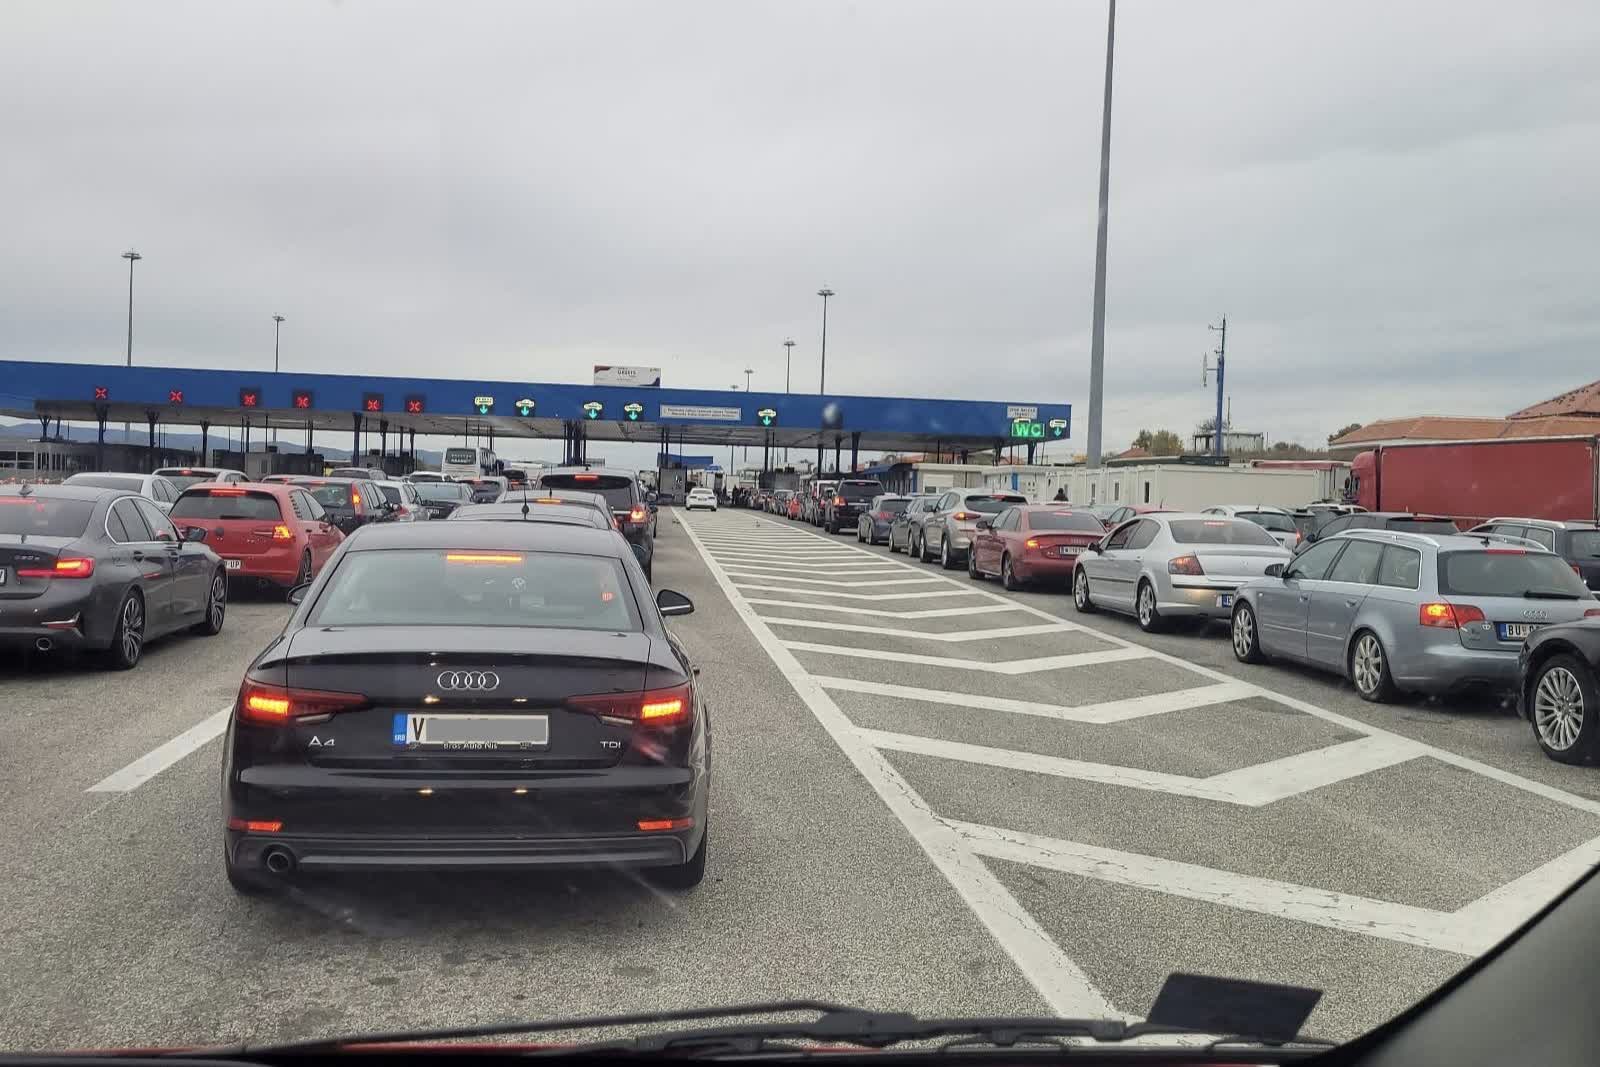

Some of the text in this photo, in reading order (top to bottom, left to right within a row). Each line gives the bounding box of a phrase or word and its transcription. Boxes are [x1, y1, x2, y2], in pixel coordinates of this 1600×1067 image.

[1015, 423, 1042, 437] WC
[307, 735, 336, 748] A4
[599, 740, 621, 749] TDI
